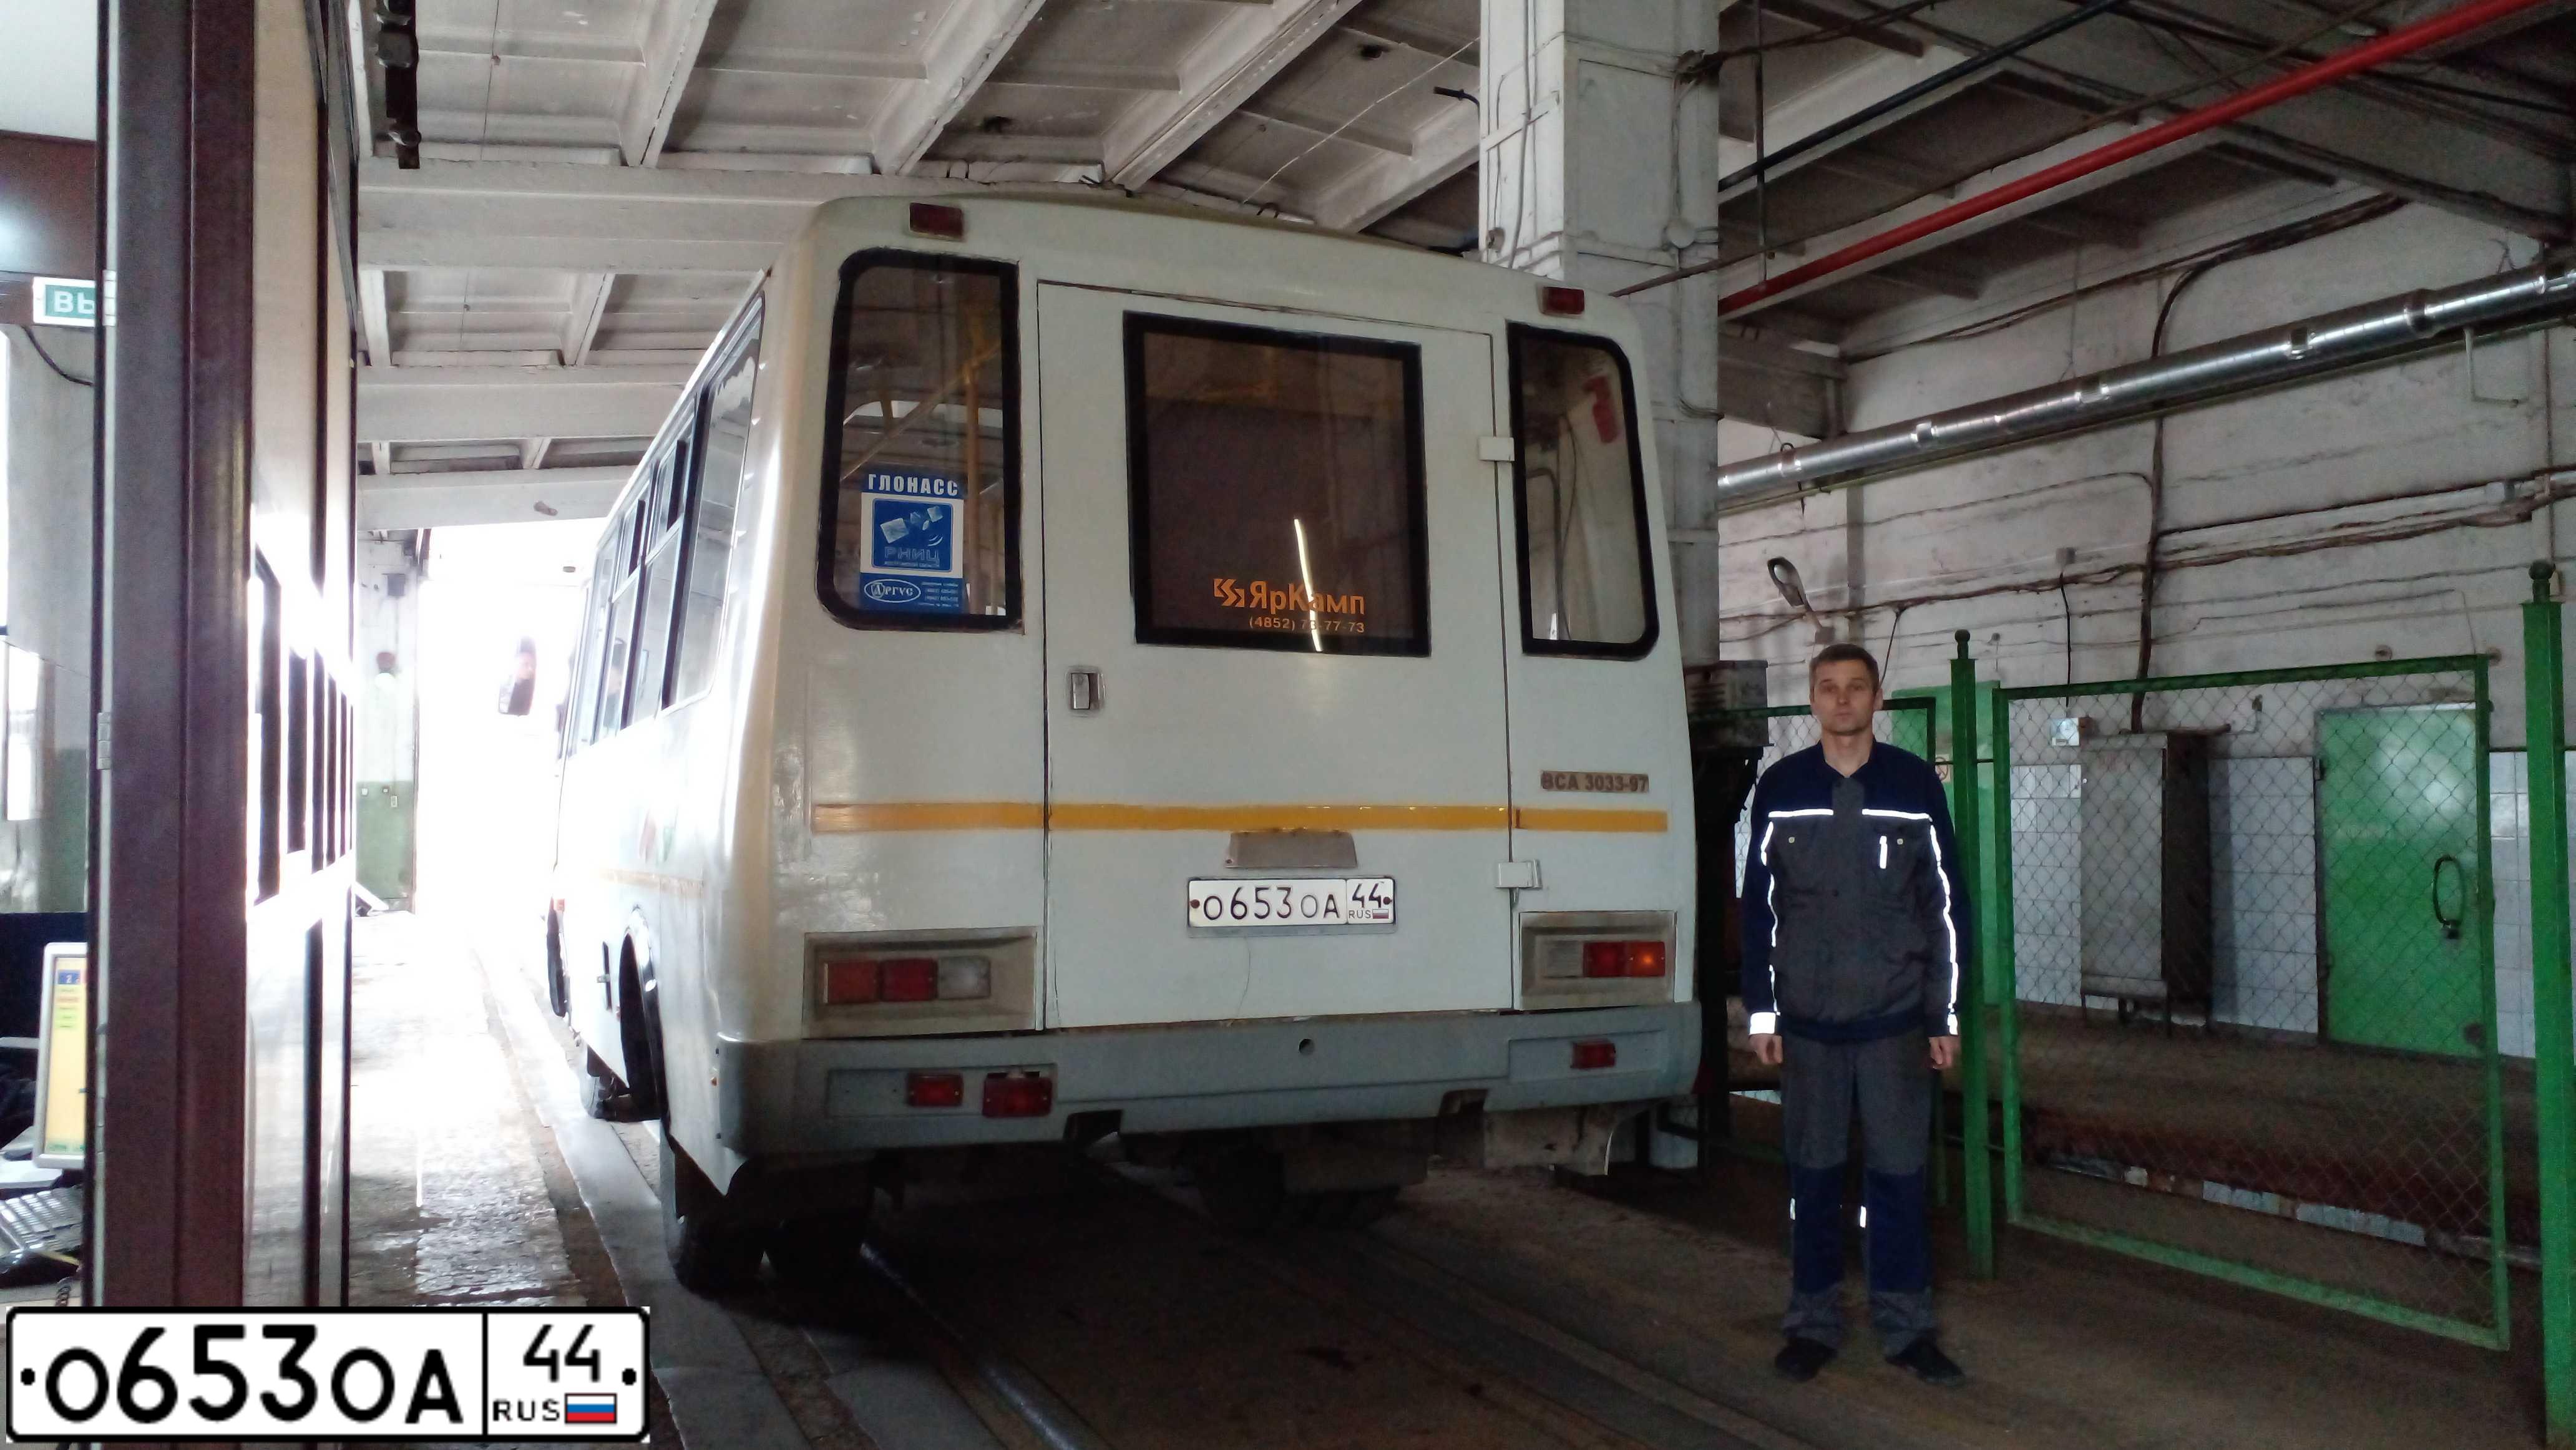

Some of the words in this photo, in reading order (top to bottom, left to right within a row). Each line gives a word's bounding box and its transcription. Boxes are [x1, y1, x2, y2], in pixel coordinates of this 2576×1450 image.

[868, 473, 959, 497] ГЛОНАСС
[884, 547, 940, 562] РНИЦ
[1249, 616, 1295, 631] (4852)
[1585, 773, 1648, 793] 3033-97
[1351, 883, 1382, 908] 44
[1348, 910, 1372, 919] RUS
